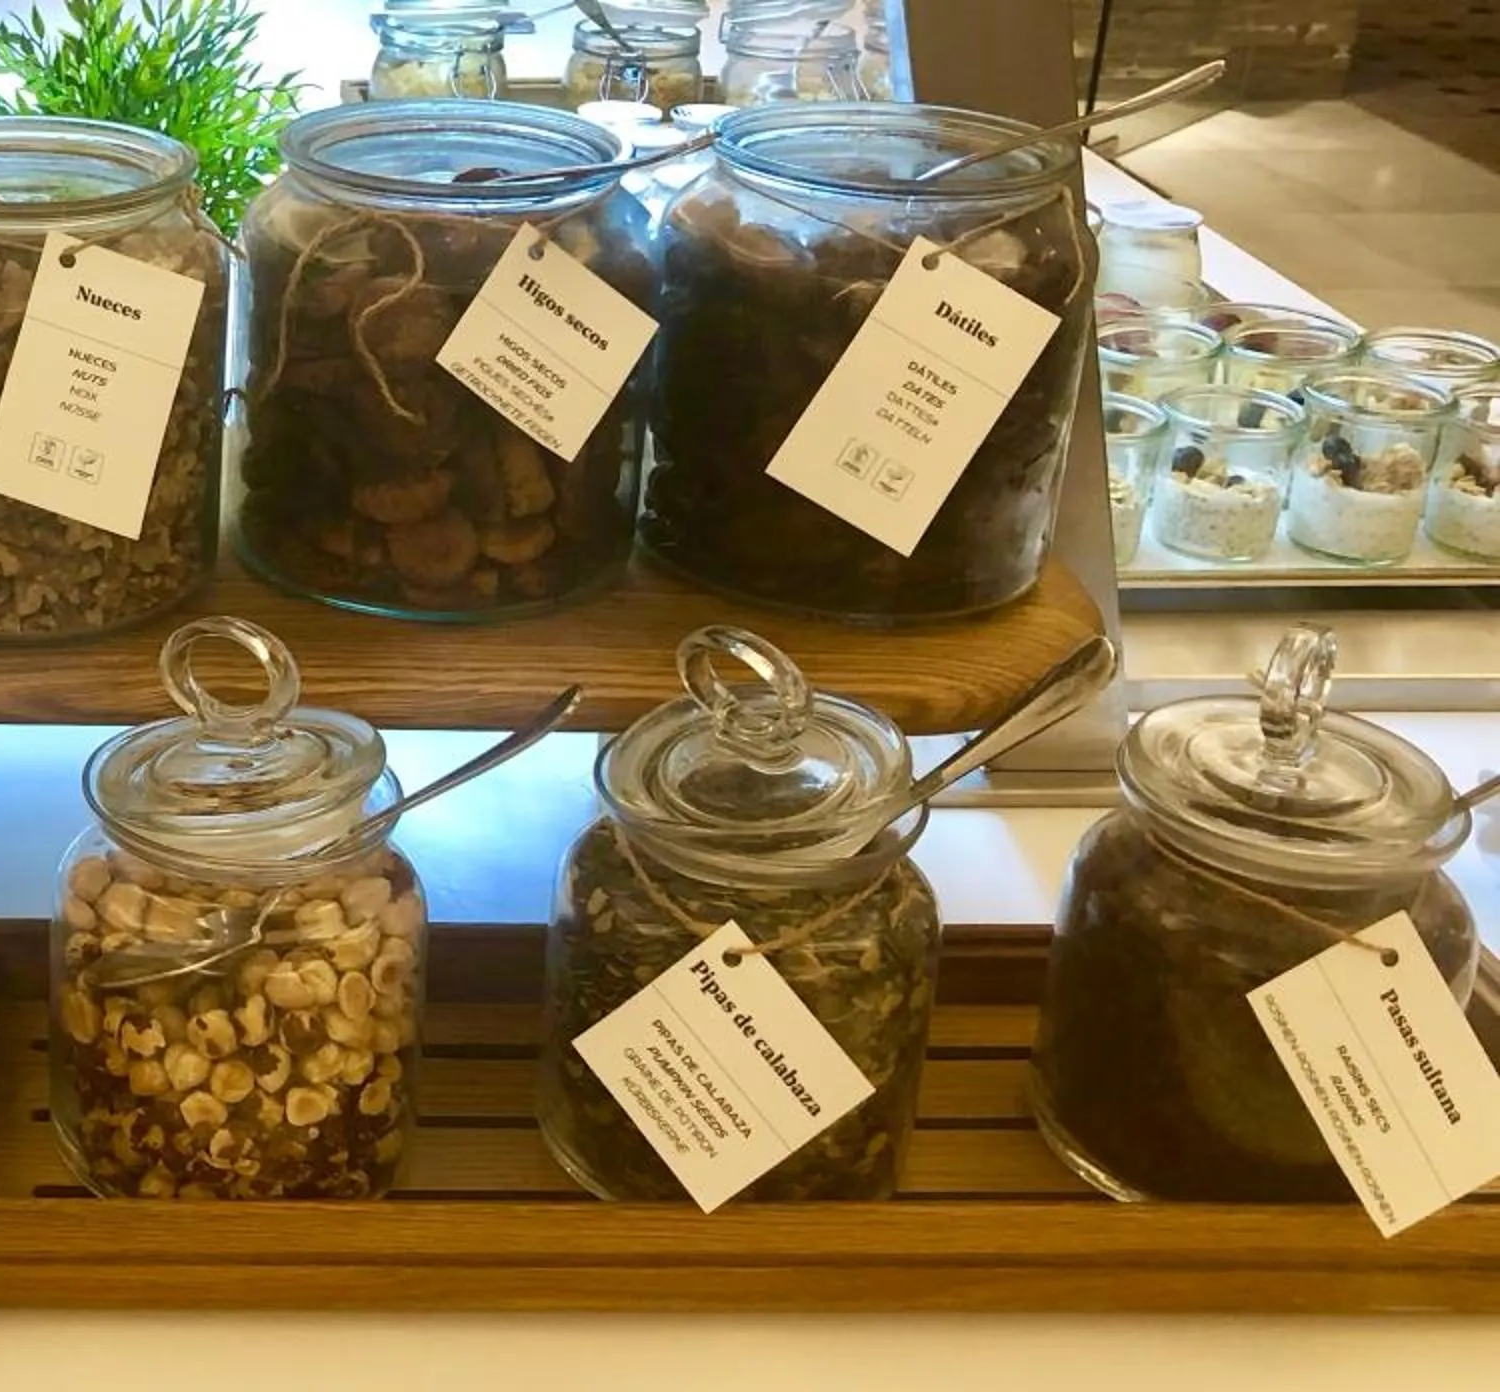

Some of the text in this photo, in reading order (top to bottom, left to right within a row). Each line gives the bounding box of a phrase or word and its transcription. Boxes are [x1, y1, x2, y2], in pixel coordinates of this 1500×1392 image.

[75, 285, 141, 321] Nueces
[517, 273, 609, 351] Higos secos
[934, 300, 998, 348] Dátiles
[67, 347, 117, 373] NUECES
[71, 368, 109, 387] NUTS
[495, 355, 554, 400] DRIED FIGS
[498, 333, 567, 389] HIGOS SECOS
[907, 360, 958, 396] DÁTILES
[901, 380, 947, 409] DATES
[689, 959, 821, 1117] Pipas de calabaza
[1379, 987, 1461, 1125] Pasas sultana
[624, 1047, 719, 1159] GRAINE DE POTIRON
[645, 1046, 729, 1139] PUMPKIN SEEDS
[651, 1018, 752, 1140] PIPAS DE CALABAZA
[1329, 1075, 1366, 1127] RAISINS
[1336, 1044, 1391, 1134] RAISINS SECS
